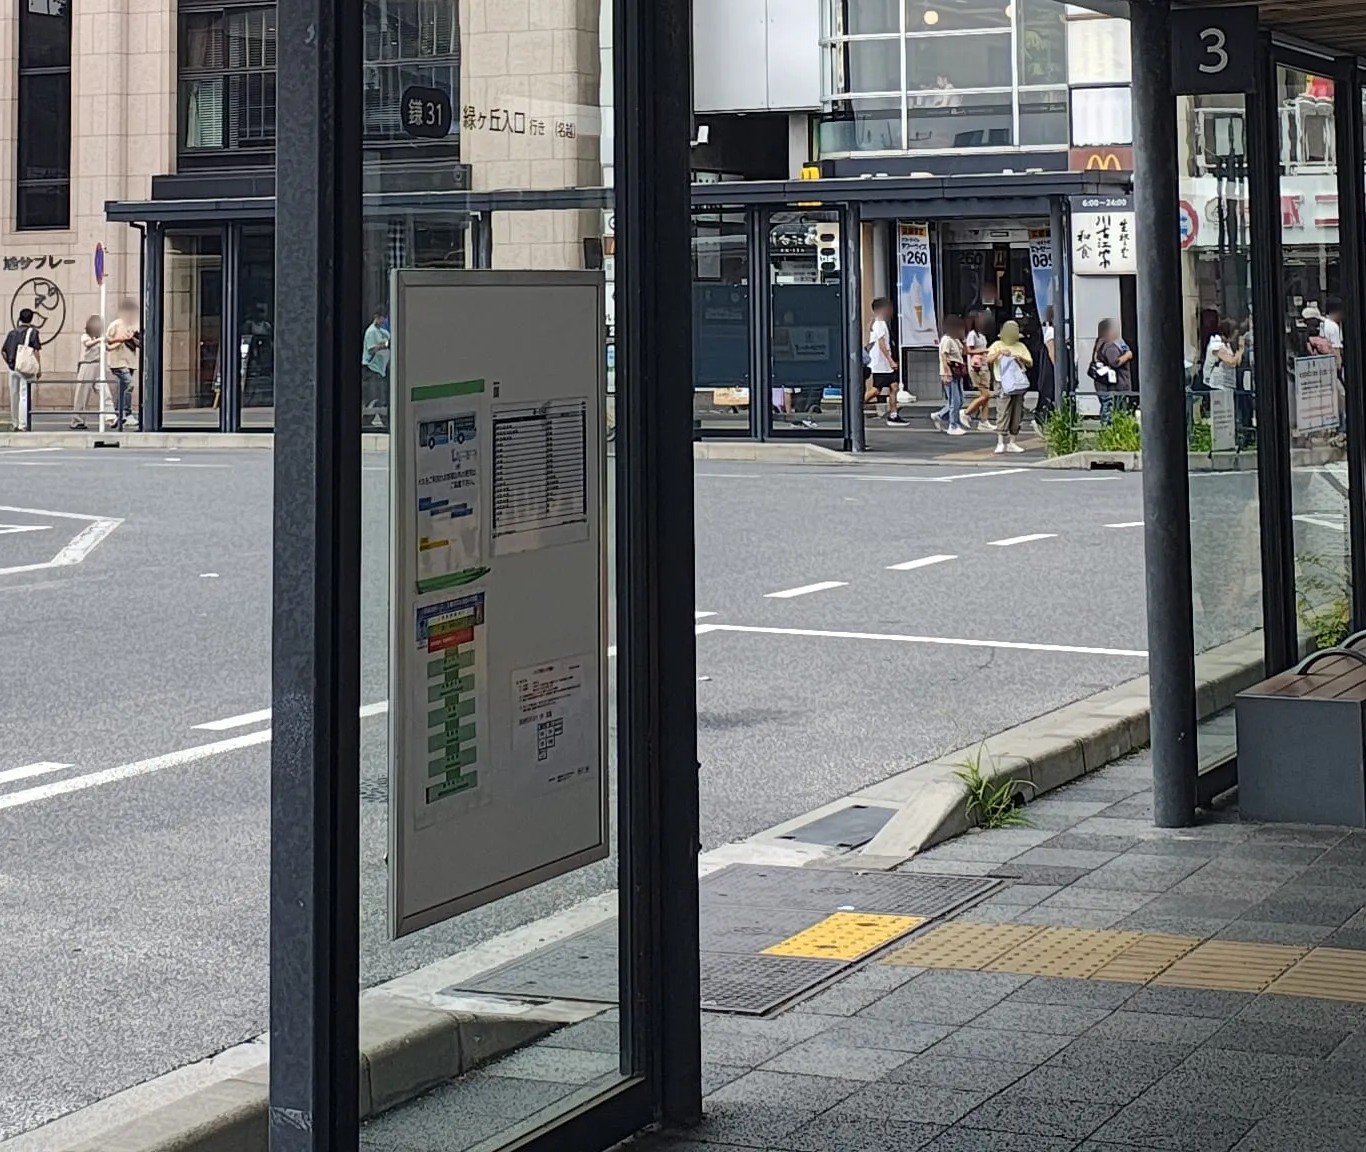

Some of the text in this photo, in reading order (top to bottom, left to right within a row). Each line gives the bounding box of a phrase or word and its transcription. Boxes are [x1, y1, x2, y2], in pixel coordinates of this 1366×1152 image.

[1197, 27, 1229, 74] 3
[1076, 229, 1093, 260] 和食
[2, 254, 76, 271] 鳩サブレー
